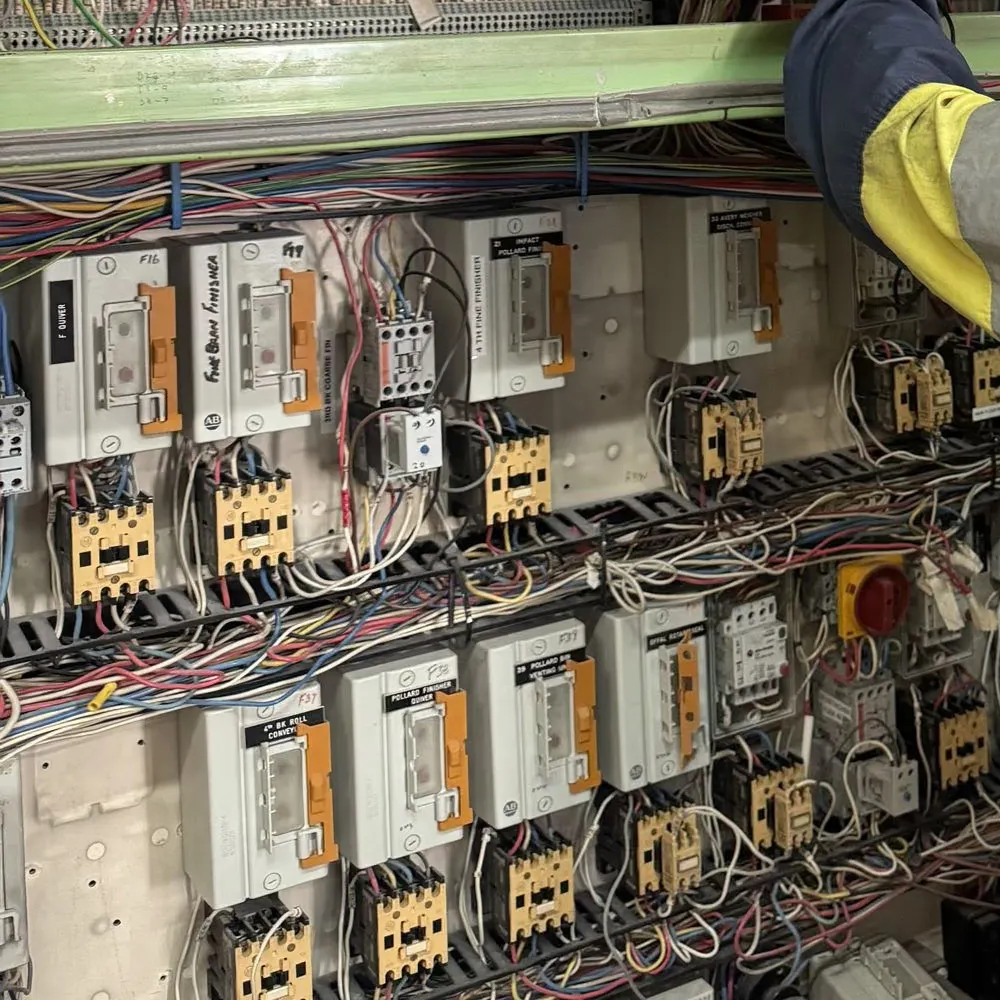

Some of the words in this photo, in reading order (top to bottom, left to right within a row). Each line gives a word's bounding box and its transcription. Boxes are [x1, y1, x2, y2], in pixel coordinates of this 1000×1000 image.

[515, 236, 540, 245] IMPACT
[498, 247, 527, 256] POLLARD
[474, 256, 482, 303] FINISHER
[58, 303, 67, 330] QUIVER
[530, 657, 559, 670] POLLARD
[529, 667, 557, 679] VENTING
[391, 689, 420, 702] POLLARD
[422, 681, 452, 694] FINISHER
[276, 720, 286, 730] BK
[289, 715, 308, 726] ROLL
[268, 726, 297, 739] CONVEY
